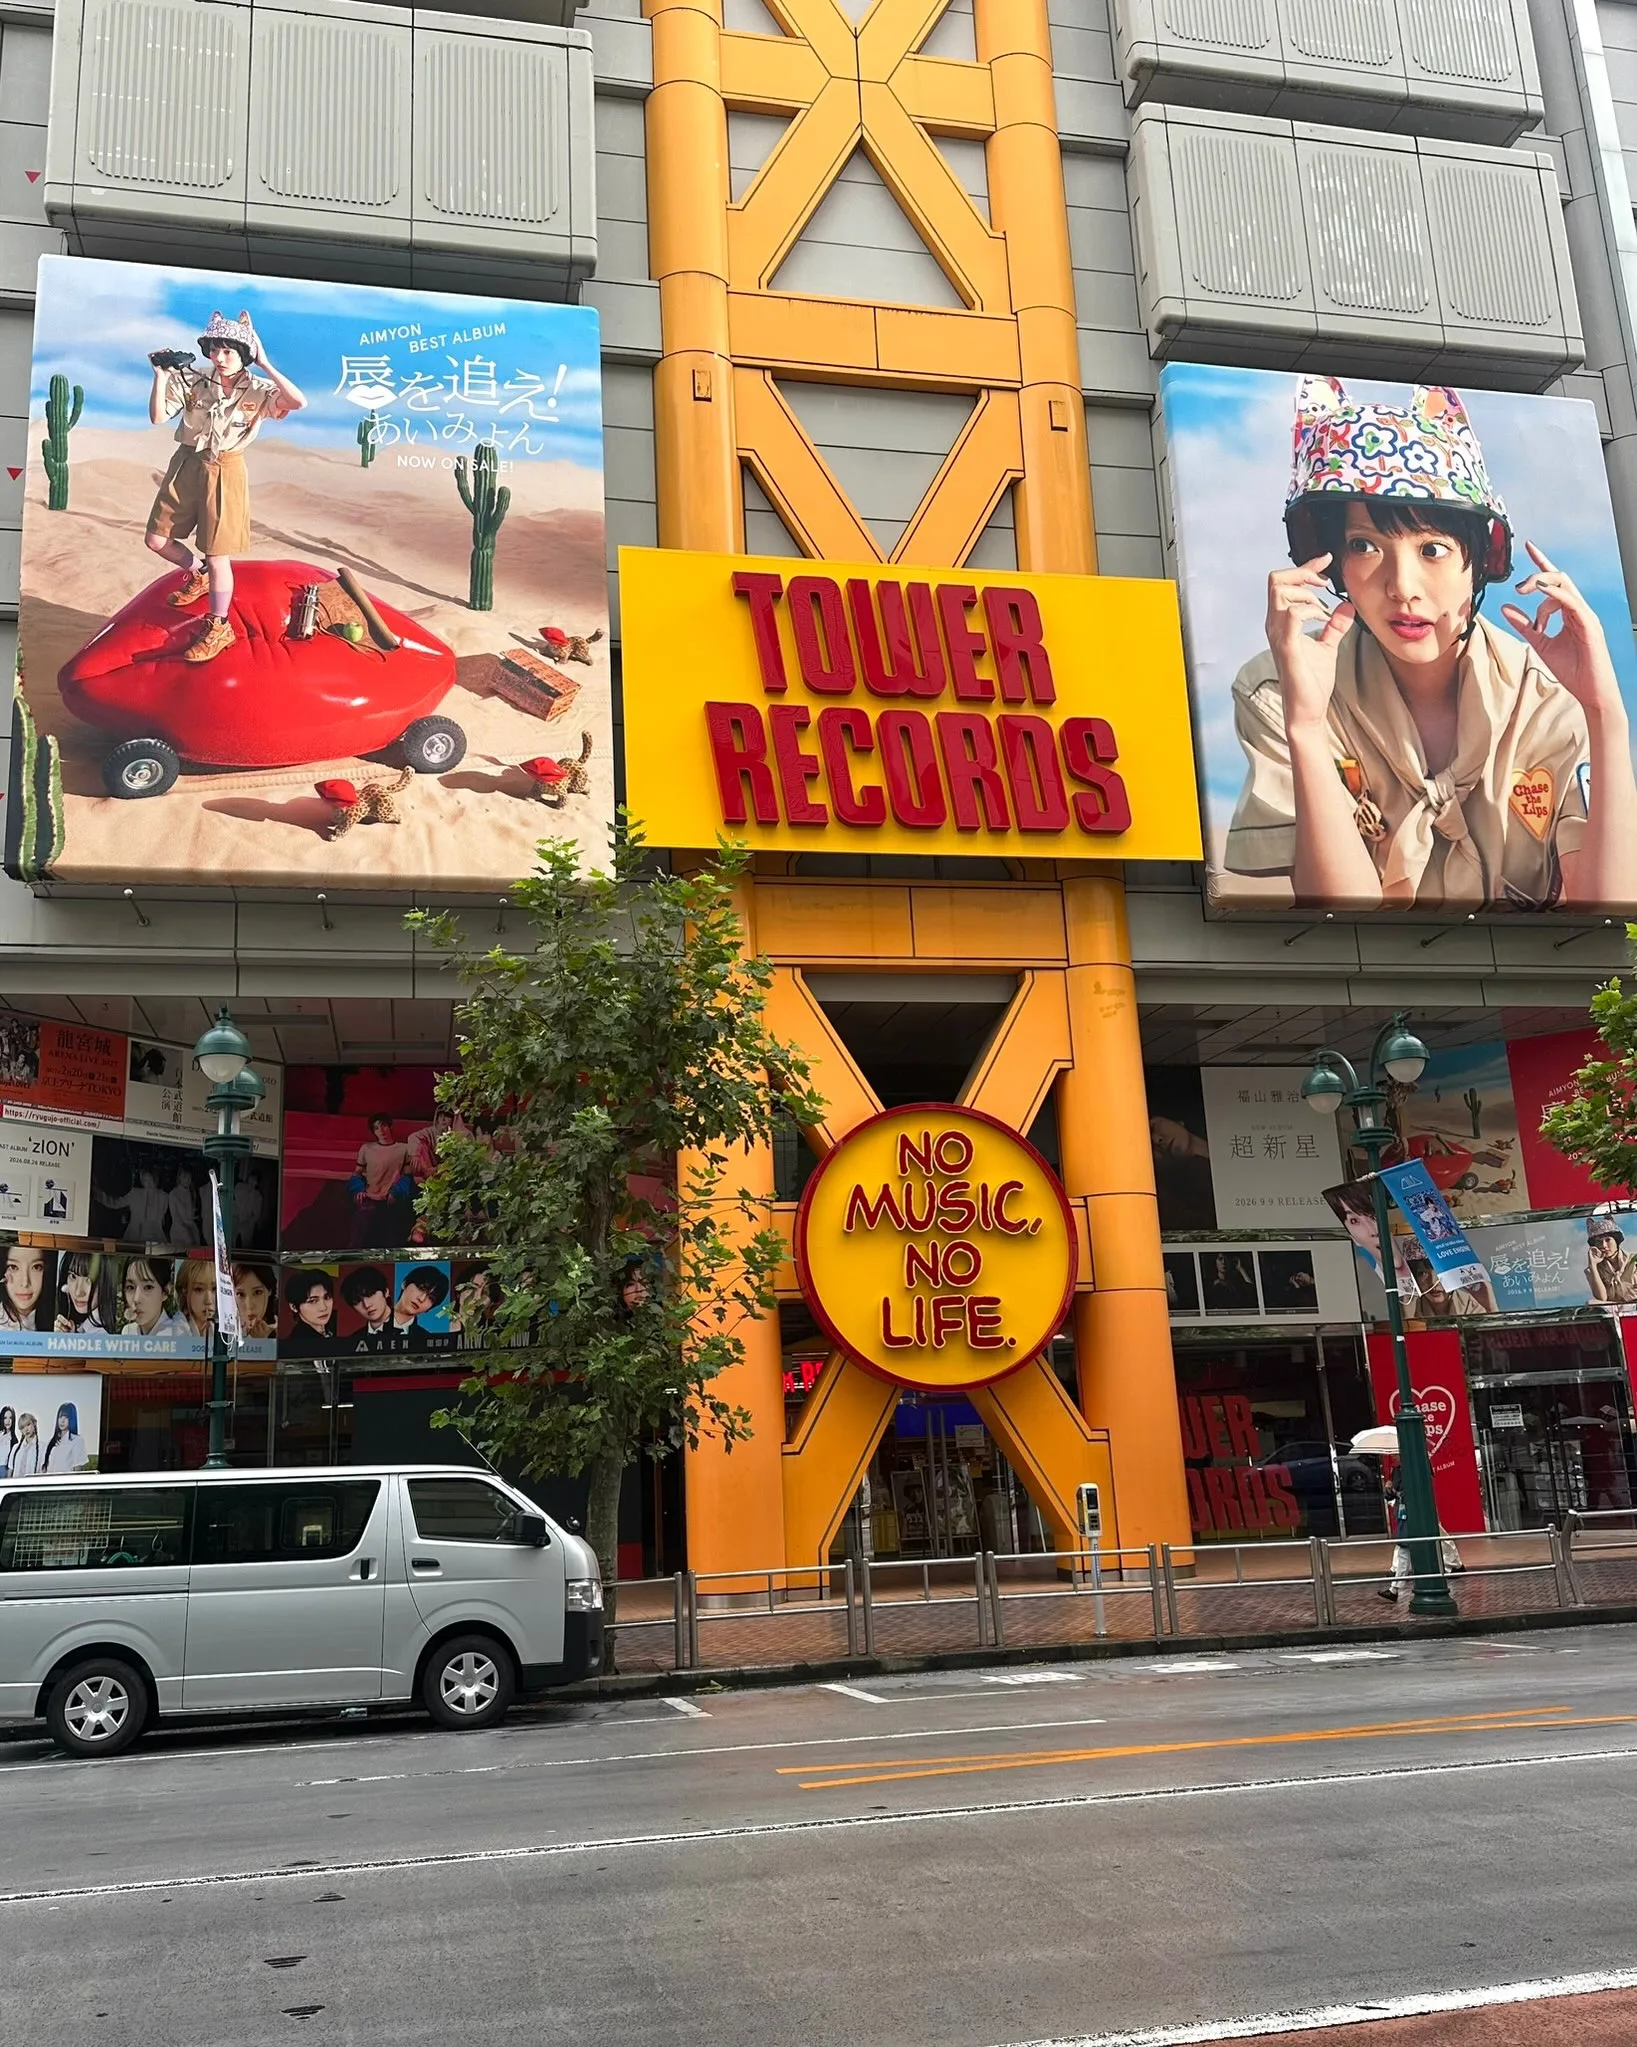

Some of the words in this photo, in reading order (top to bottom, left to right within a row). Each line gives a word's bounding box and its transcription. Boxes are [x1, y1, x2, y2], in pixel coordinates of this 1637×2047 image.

[360, 323, 422, 346] AIMYON
[409, 334, 447, 353] BEST
[452, 322, 507, 345] ALBUM
[363, 412, 544, 456] あいみょん
[397, 455, 436, 470] NOW
[441, 457, 464, 471] ON
[470, 458, 514, 474] SALE!
[731, 571, 1057, 705] TOWER
[703, 700, 1133, 835] RECORDS
[1512, 782, 1549, 798] Chase
[1526, 794, 1542, 805] the
[1522, 803, 1549, 818] Lips
[1548, 1079, 1580, 1098] AIMYON
[898, 1130, 974, 1177] NO
[1229, 1134, 1320, 1160] 超新星
[39, 1160, 61, 1168] RELEASE
[843, 1179, 1043, 1236] MUSIC,
[1278, 1196, 1326, 1207] RELEASE
[904, 1240, 982, 1288] NO
[1502, 1271, 1565, 1288] あいみょん
[881, 1294, 1017, 1349] LIFE.
[47, 1337, 101, 1352] HANDLE
[104, 1339, 141, 1353] WITH
[143, 1340, 177, 1354] CARE
[1180, 1394, 1262, 1459] WER
[1425, 1424, 1444, 1437] ps
[1436, 1460, 1456, 1472] ALBUM
[1185, 1464, 1300, 1532] ORDS
